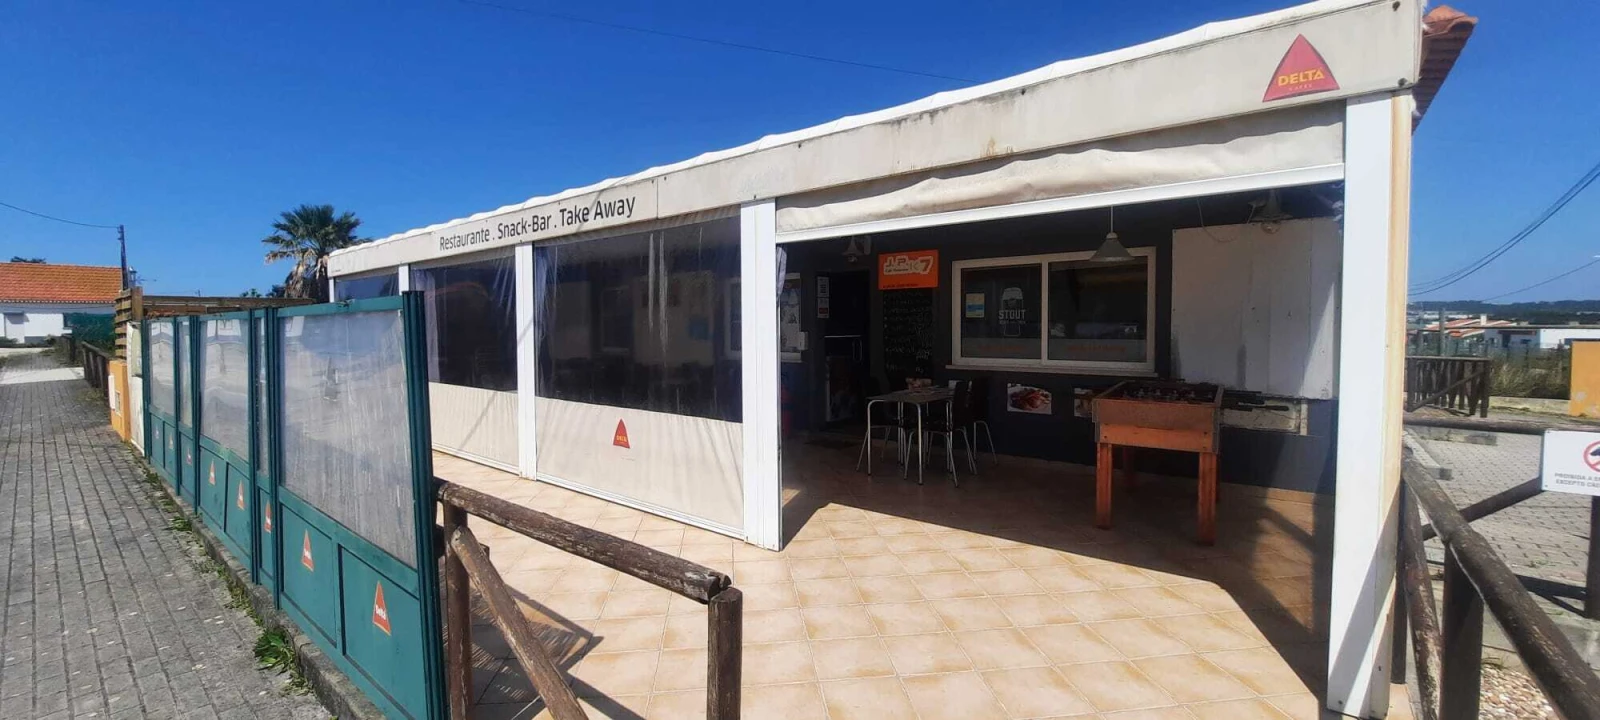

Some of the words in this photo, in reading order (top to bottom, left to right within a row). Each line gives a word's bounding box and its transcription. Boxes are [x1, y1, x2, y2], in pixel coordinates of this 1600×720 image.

[1278, 68, 1324, 86] DELTA
[439, 228, 490, 251] Restaurante
[497, 214, 552, 240] Snack-Bar
[559, 204, 590, 227] Take
[593, 196, 636, 220] Away
[998, 309, 1026, 320] STOUT
